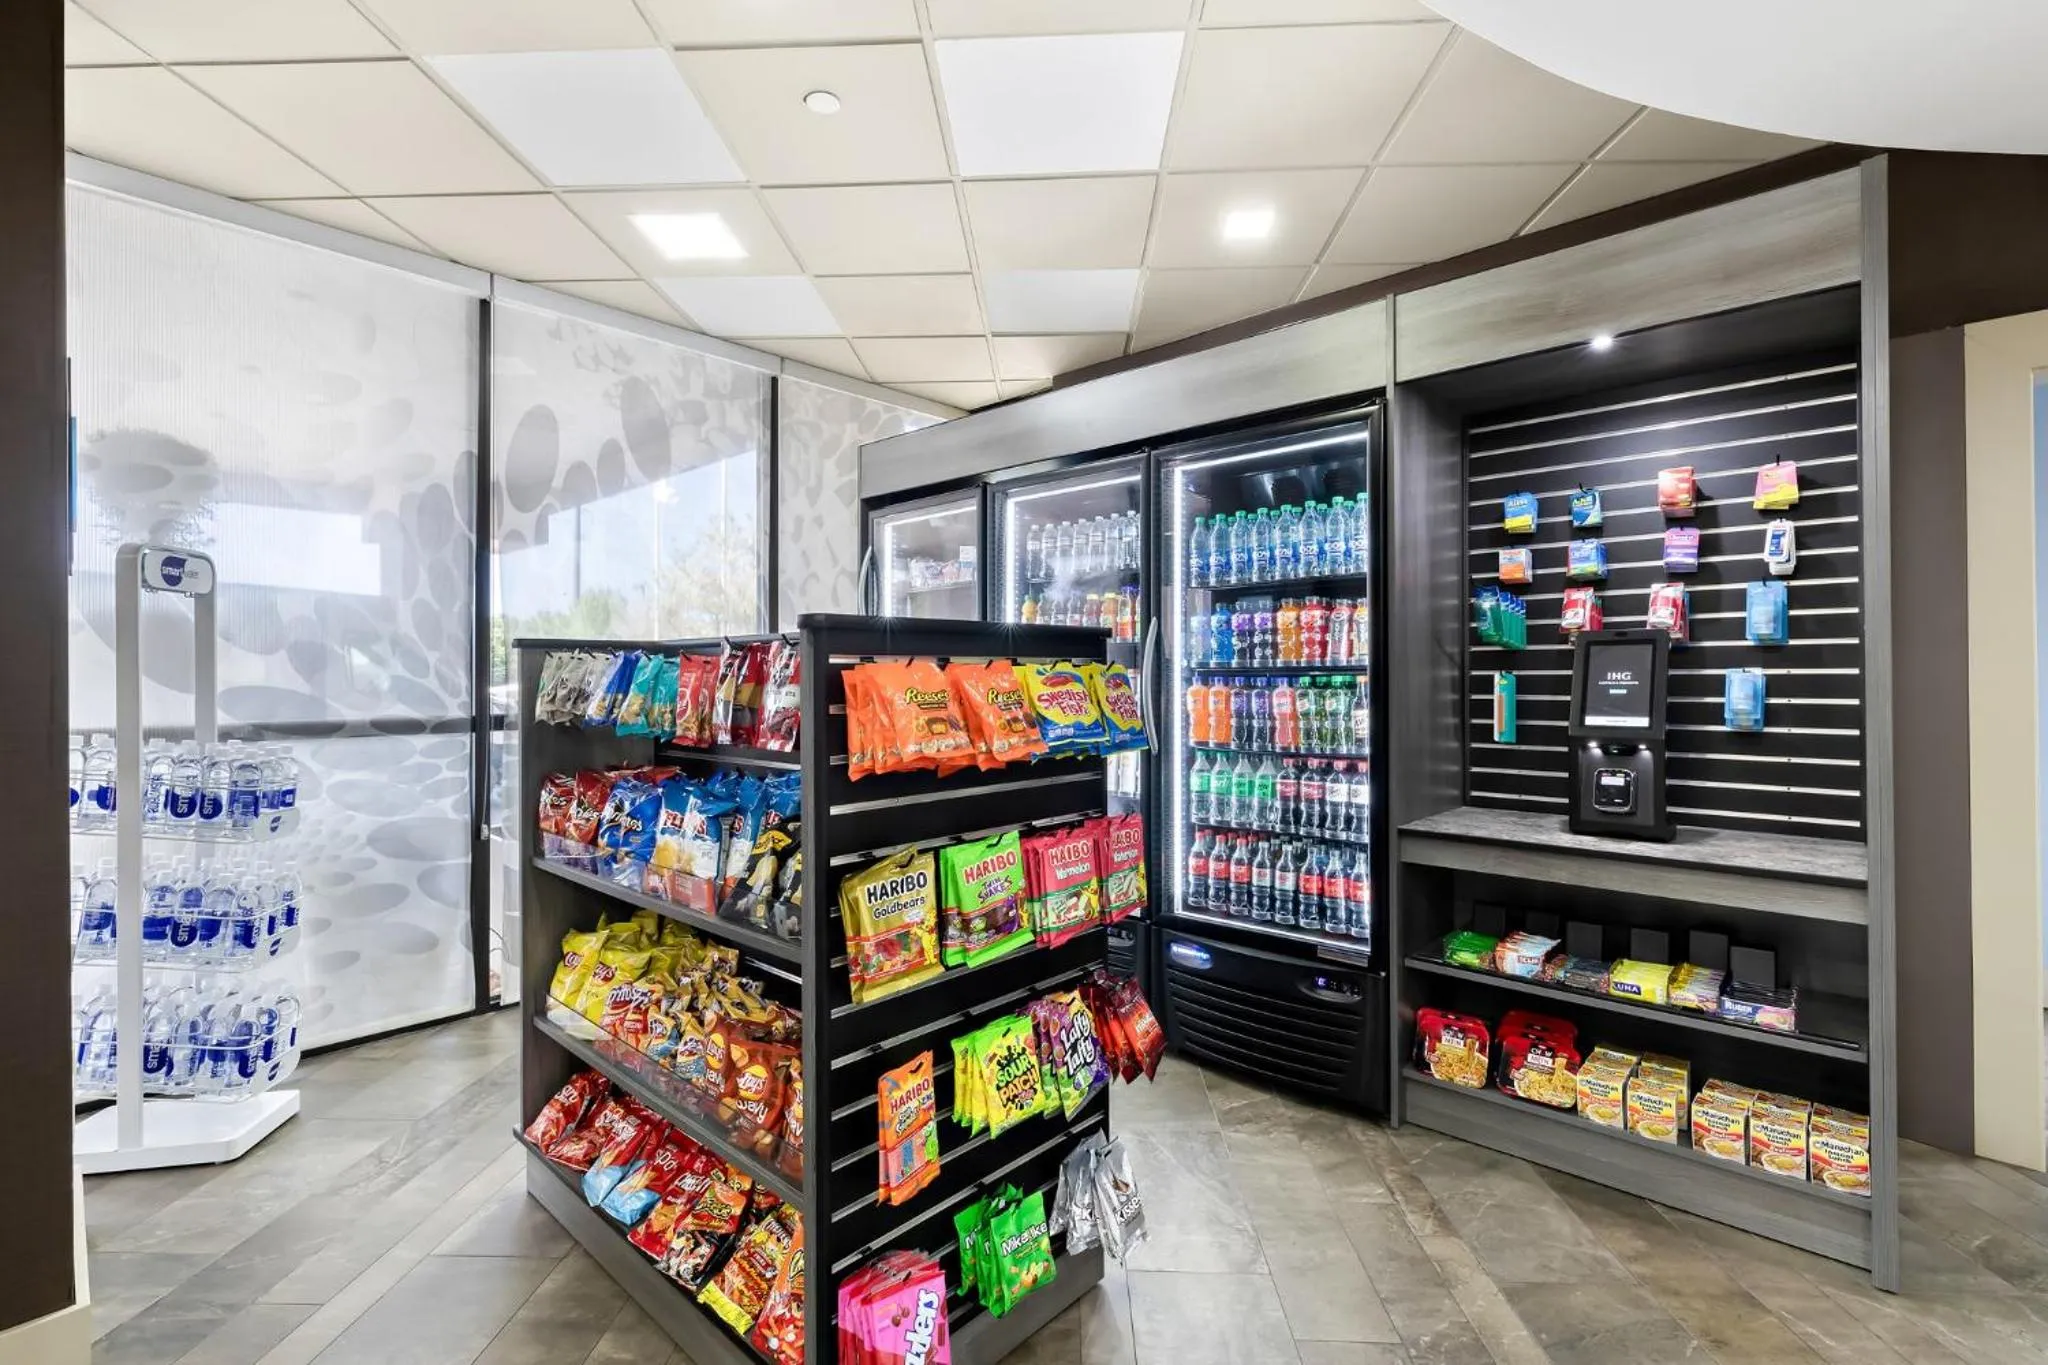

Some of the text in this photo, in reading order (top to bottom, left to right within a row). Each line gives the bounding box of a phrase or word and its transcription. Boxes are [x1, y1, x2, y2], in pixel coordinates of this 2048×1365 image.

[1606, 671, 1632, 681] IHG
[963, 850, 1018, 885] HARIBO
[866, 870, 929, 905] HARIBO
[873, 896, 926, 920] Goldbears
[1060, 1009, 1092, 1052] Laffy
[996, 1054, 1034, 1087] SOUR
[1063, 1036, 1095, 1077] Taffy
[889, 1078, 931, 1115] HARIBO
[999, 1066, 1041, 1108] PATCH
